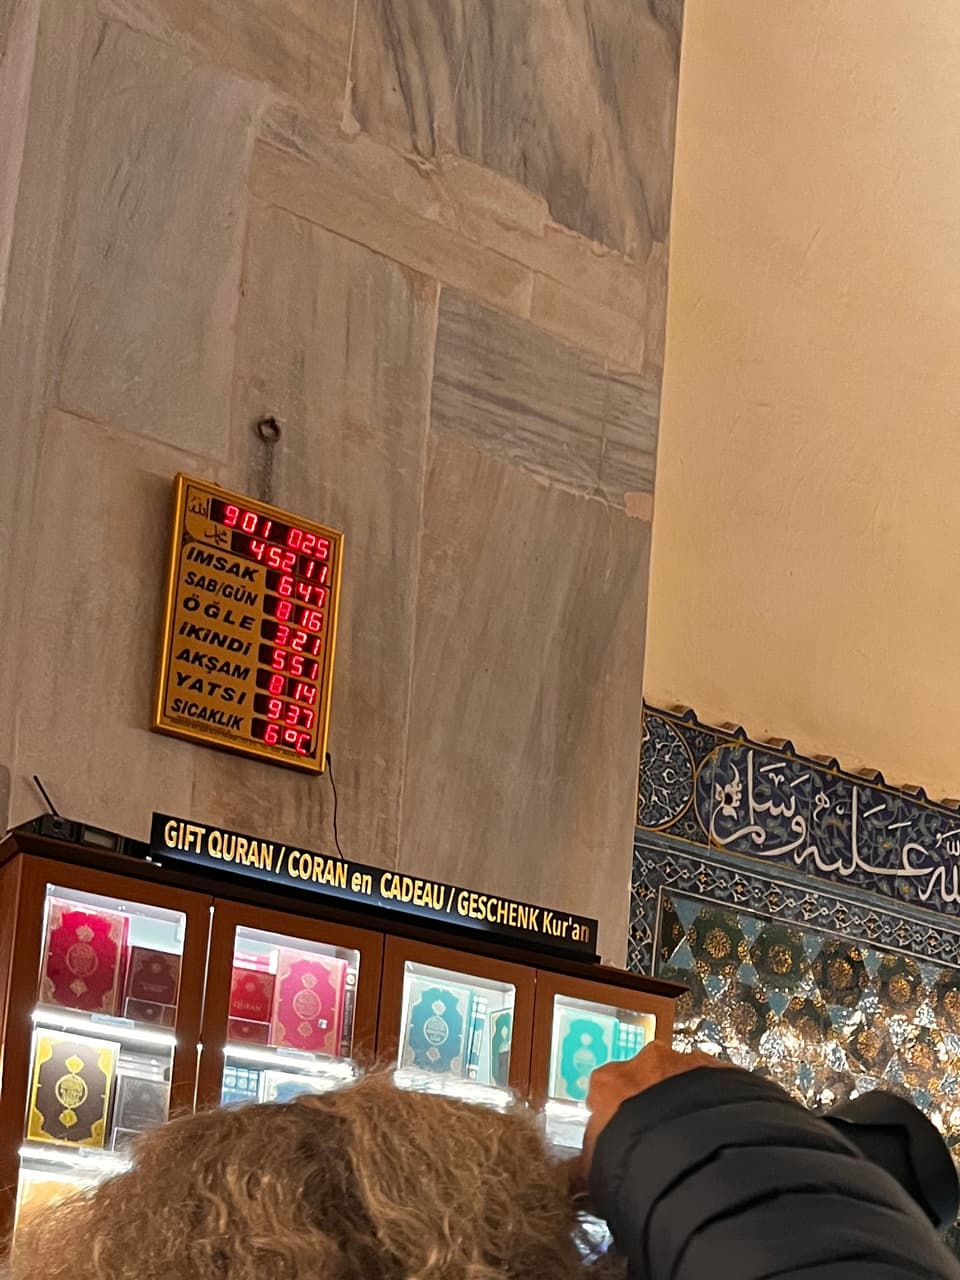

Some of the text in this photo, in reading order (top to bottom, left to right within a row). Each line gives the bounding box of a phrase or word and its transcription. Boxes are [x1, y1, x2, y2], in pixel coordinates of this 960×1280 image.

[176, 648, 250, 681] AKŞAM
[175, 671, 246, 705] YATSI
[171, 697, 245, 731] SICAKLIK
[164, 820, 206, 854] GIFT
[207, 830, 274, 871] QURAN
[287, 850, 349, 889] CORAN
[351, 871, 373, 895] en
[379, 872, 446, 910] CADEAU
[457, 890, 540, 932] GESCHENK
[542, 910, 590, 943] Kur'an
